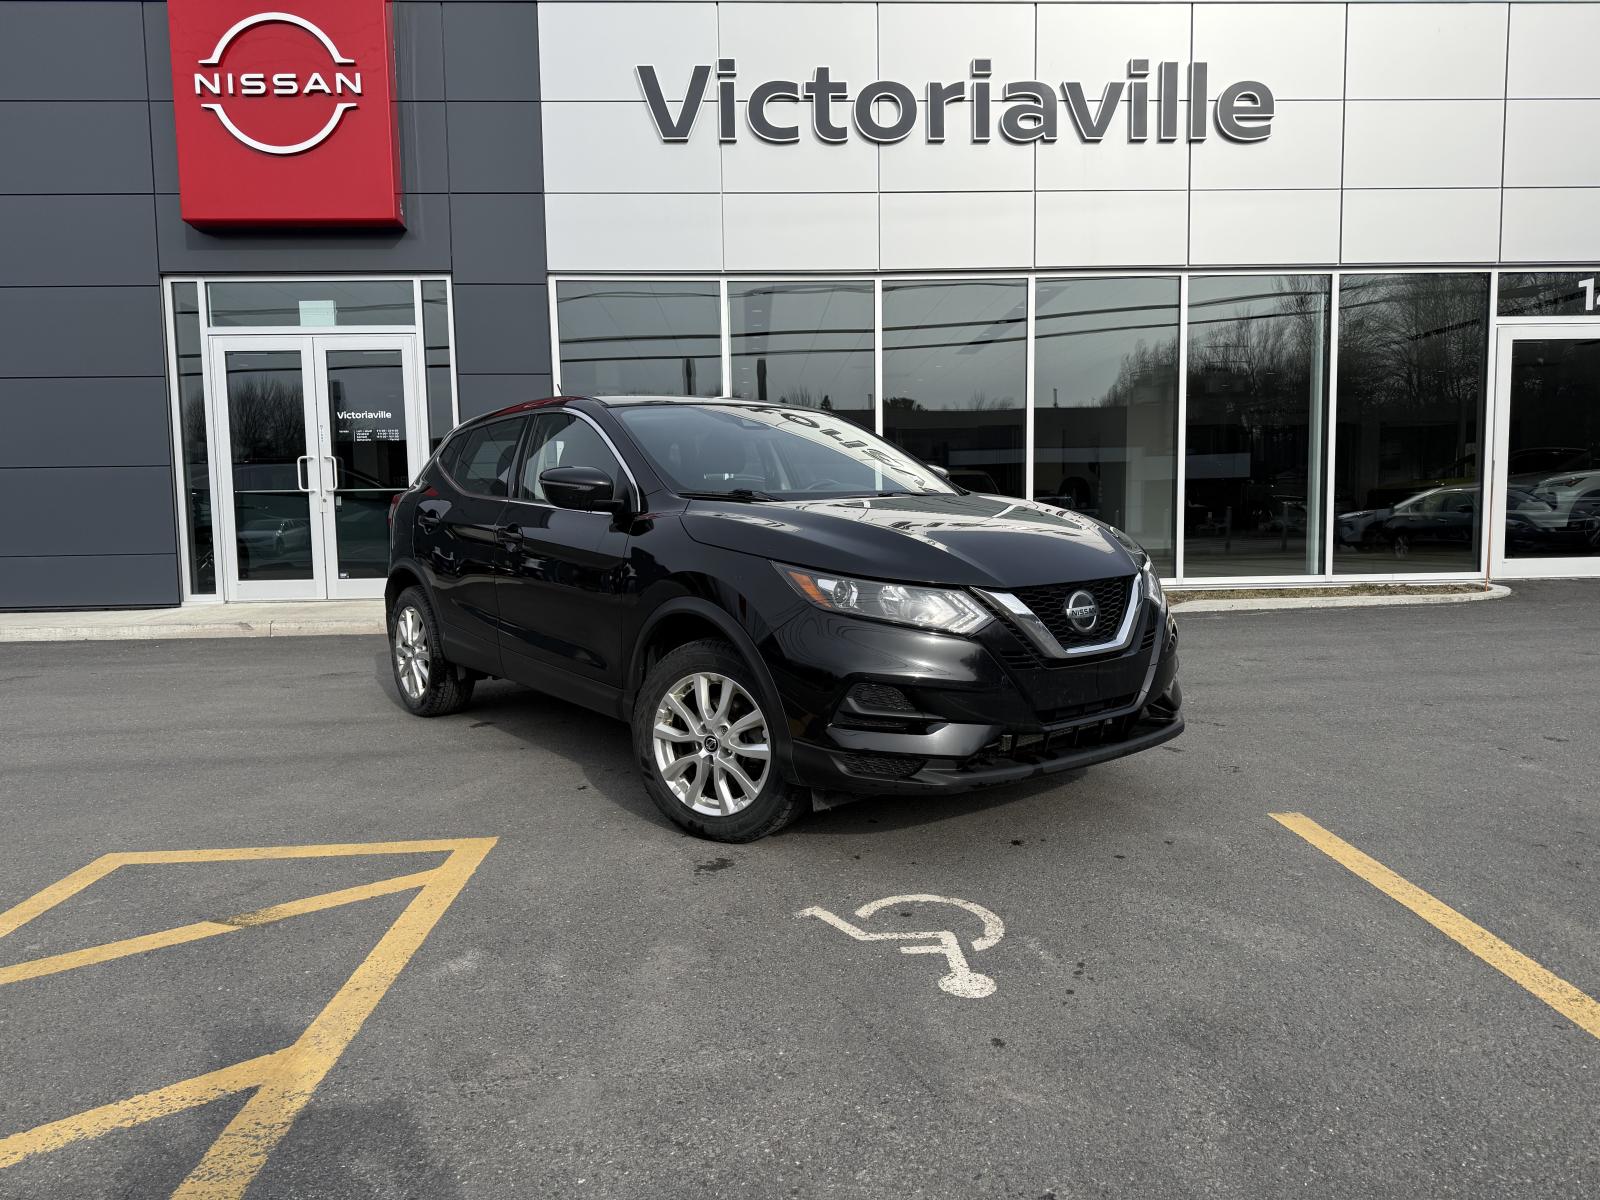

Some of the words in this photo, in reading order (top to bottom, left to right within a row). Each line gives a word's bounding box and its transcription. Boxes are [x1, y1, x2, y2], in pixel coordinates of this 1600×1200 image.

[193, 72, 362, 95] NISSAN
[635, 58, 1276, 144] Victoriaville
[1578, 277, 1600, 311] 1
[336, 411, 392, 419] Victoriaville
[1071, 607, 1096, 616] NISSAN
